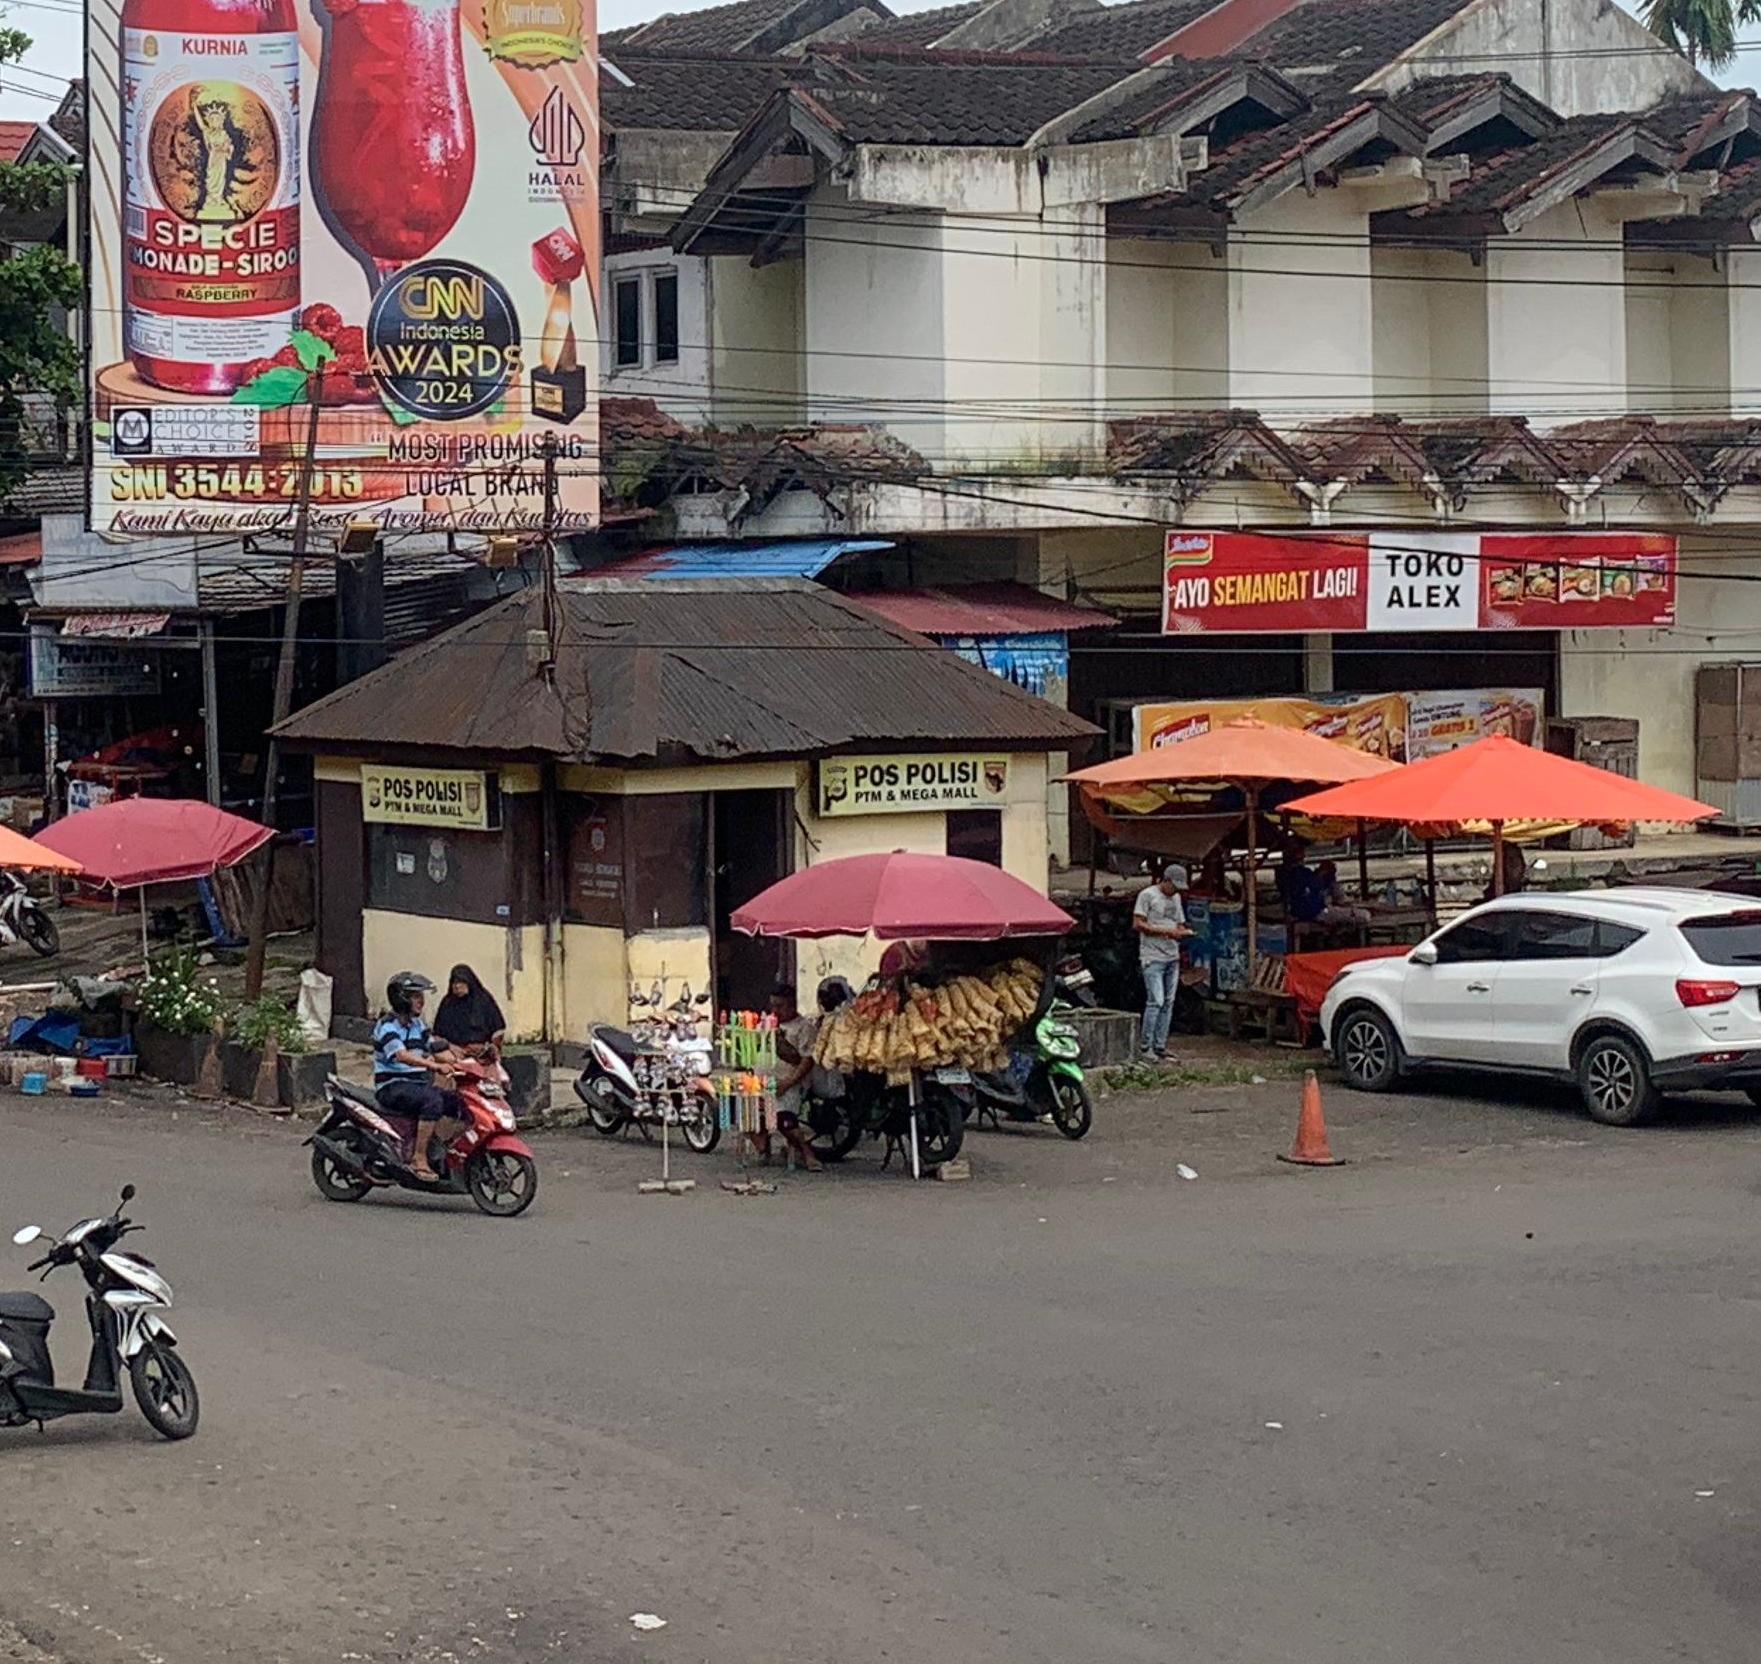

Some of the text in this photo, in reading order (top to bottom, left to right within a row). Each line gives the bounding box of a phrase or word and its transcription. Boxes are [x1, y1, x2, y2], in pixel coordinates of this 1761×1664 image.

[182, 39, 248, 55] KURNIA
[528, 172, 585, 186] HALAL
[155, 220, 276, 250] SPECIE
[176, 288, 258, 301] RASPBERRY
[399, 275, 484, 320] CNN
[400, 322, 485, 340] Indonesia
[365, 343, 525, 377] AWARDS
[415, 381, 474, 403] 2024
[154, 408, 236, 423] EDITOR'S
[154, 424, 236, 439] CHOICE
[459, 432, 582, 460] PROMISNG
[110, 463, 167, 500] SNI
[405, 468, 476, 497] LOCAL
[108, 507, 170, 532] Kami
[171, 507, 235, 536] Kaya
[459, 508, 500, 528] dan
[1385, 552, 1464, 578] TOKO
[1173, 566, 1359, 610] AYO SEMANGAT LAGI!
[1386, 584, 1461, 608] ALEX
[854, 761, 978, 788] POS POLISI
[383, 777, 462, 803] POS POLISI
[854, 786, 979, 804] PTM & MEGA MALL
[412, 802, 438, 815] MEGA
[439, 804, 464, 817] MALL
